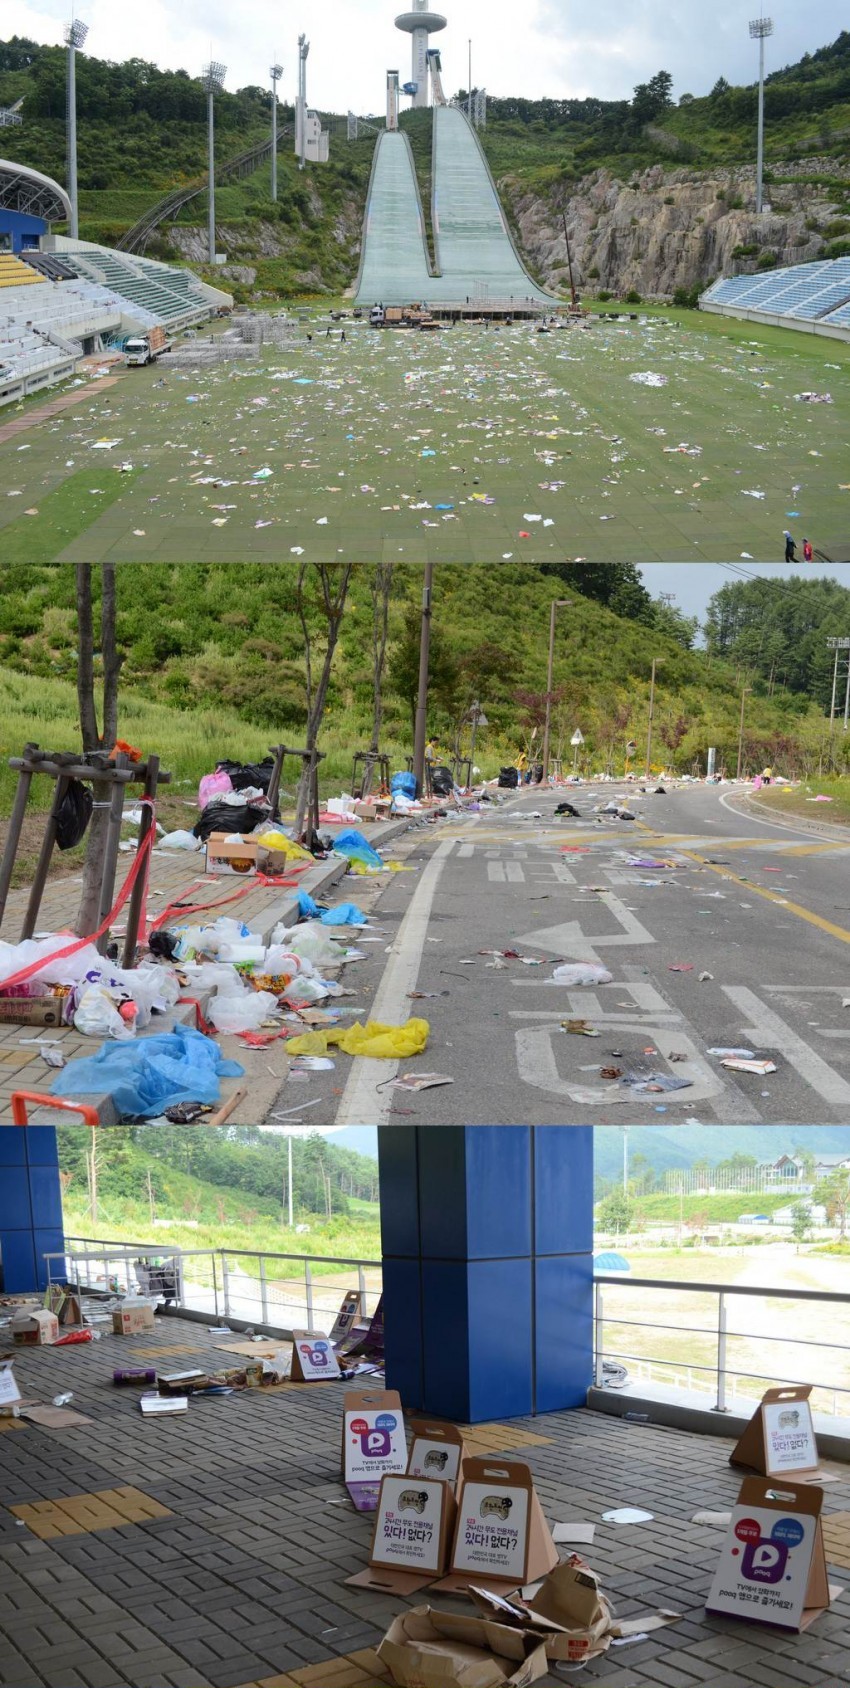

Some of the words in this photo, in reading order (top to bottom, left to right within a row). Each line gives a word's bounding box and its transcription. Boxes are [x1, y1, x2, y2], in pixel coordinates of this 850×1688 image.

[383, 1525, 406, 1540] 있다!
[408, 1528, 433, 1543] 없다?
[465, 1532, 489, 1547] 있다!
[490, 1535, 518, 1551] 없다?
[718, 1589, 737, 1599] pooq
